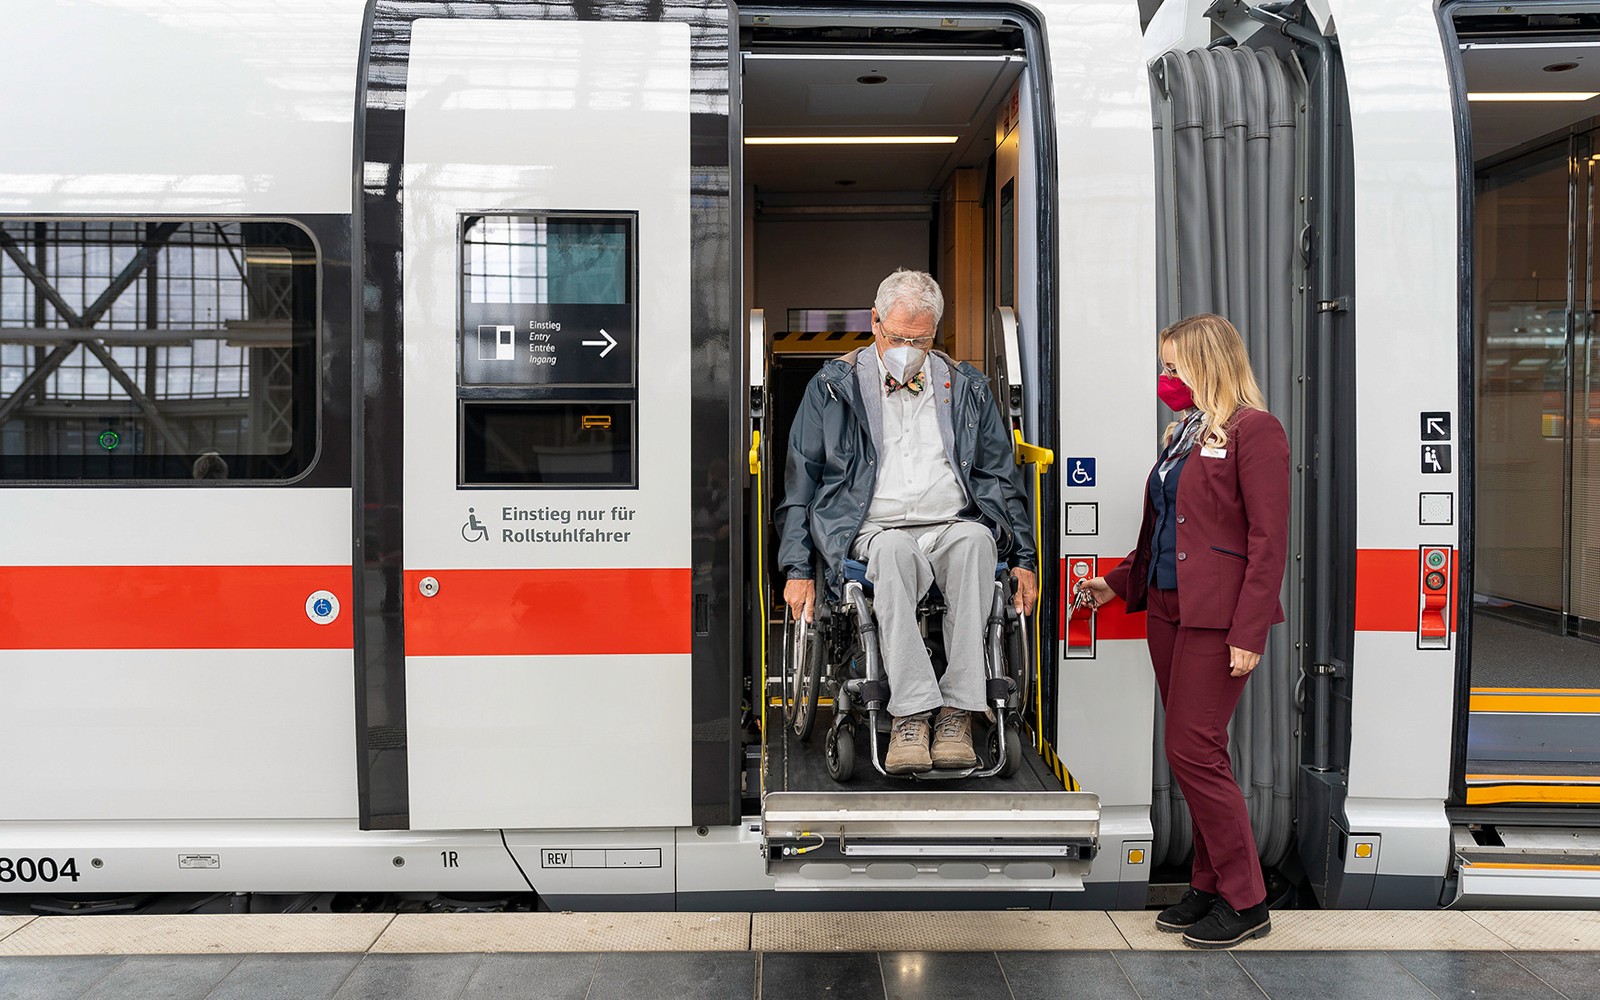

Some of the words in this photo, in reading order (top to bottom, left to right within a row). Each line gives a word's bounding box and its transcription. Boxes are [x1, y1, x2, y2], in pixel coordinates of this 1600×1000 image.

[529, 320, 561, 331] Einstieg
[529, 332, 551, 342] Entry
[529, 343, 556, 353] Entrée
[529, 355, 557, 366] Ingang
[502, 506, 571, 524] Einstieg
[577, 509, 606, 521] nur
[611, 506, 636, 521] für
[502, 528, 631, 543] Rollstuhlfahrer
[440, 851, 459, 868] 1R
[547, 853, 568, 865] REV
[0, 857, 80, 883] 8004
